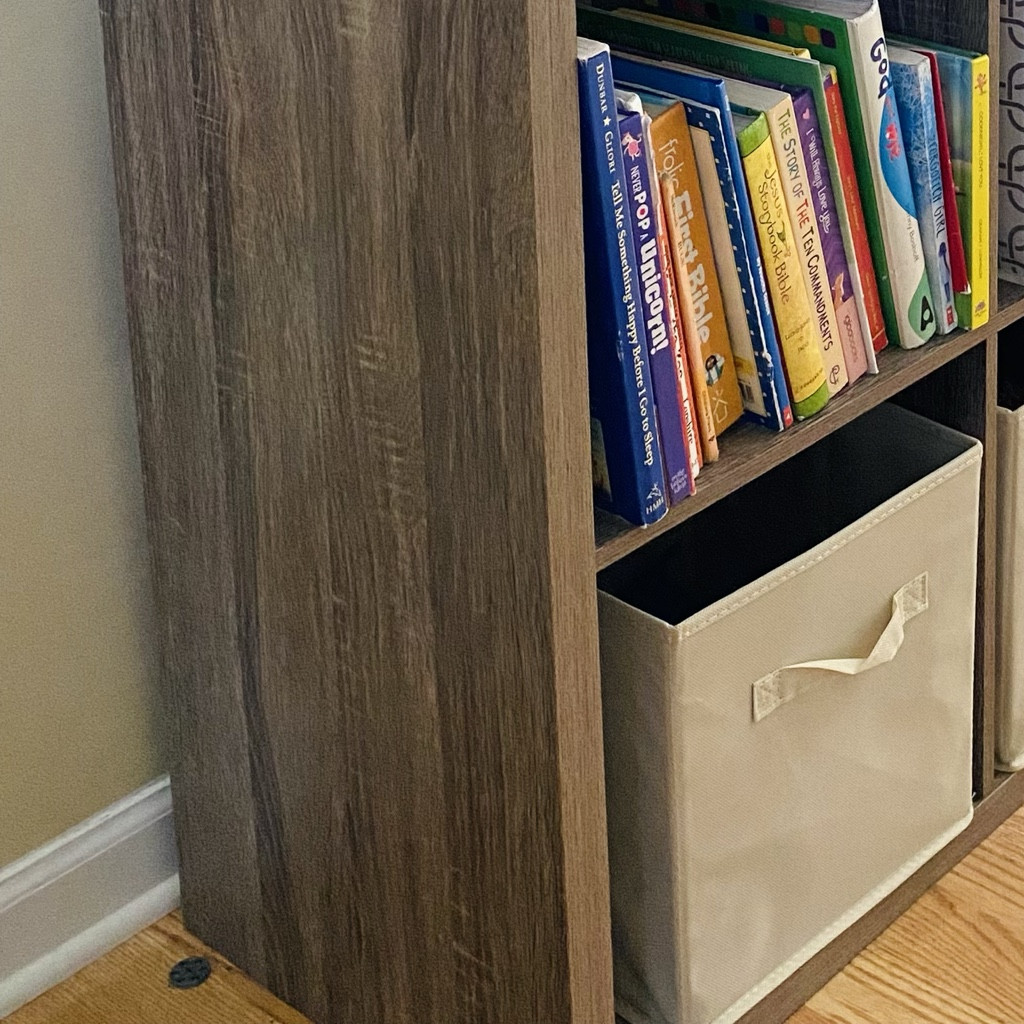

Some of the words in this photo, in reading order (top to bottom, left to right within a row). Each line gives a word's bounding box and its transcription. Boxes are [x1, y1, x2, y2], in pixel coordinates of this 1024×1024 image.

[595, 62, 608, 114] DUNBAR
[777, 108, 792, 140] THE
[604, 131, 616, 174] GLIORI
[783, 138, 801, 181] STORY
[611, 180, 623, 207] Tell
[630, 165, 643, 194] NEVER
[764, 169, 784, 220] Jesus
[792, 182, 804, 198] OF
[817, 186, 828, 210] Love
[614, 205, 625, 229] Me
[633, 190, 650, 231] POP
[796, 198, 810, 229] THE
[933, 202, 946, 239] GIRL
[639, 233, 649, 242] A
[758, 181, 783, 263] Storybook
[774, 261, 791, 306] Bible
[802, 226, 815, 257] TEN
[617, 228, 633, 304] Something
[674, 190, 698, 264] First
[690, 263, 711, 344] Bible
[640, 237, 669, 356] Unicorn!
[807, 253, 834, 352] COMMANDMENTS
[626, 300, 639, 345] Happy
[631, 344, 645, 388] Before
[639, 397, 649, 417] Go
[641, 418, 649, 432] to
[643, 430, 654, 466] Sleep
